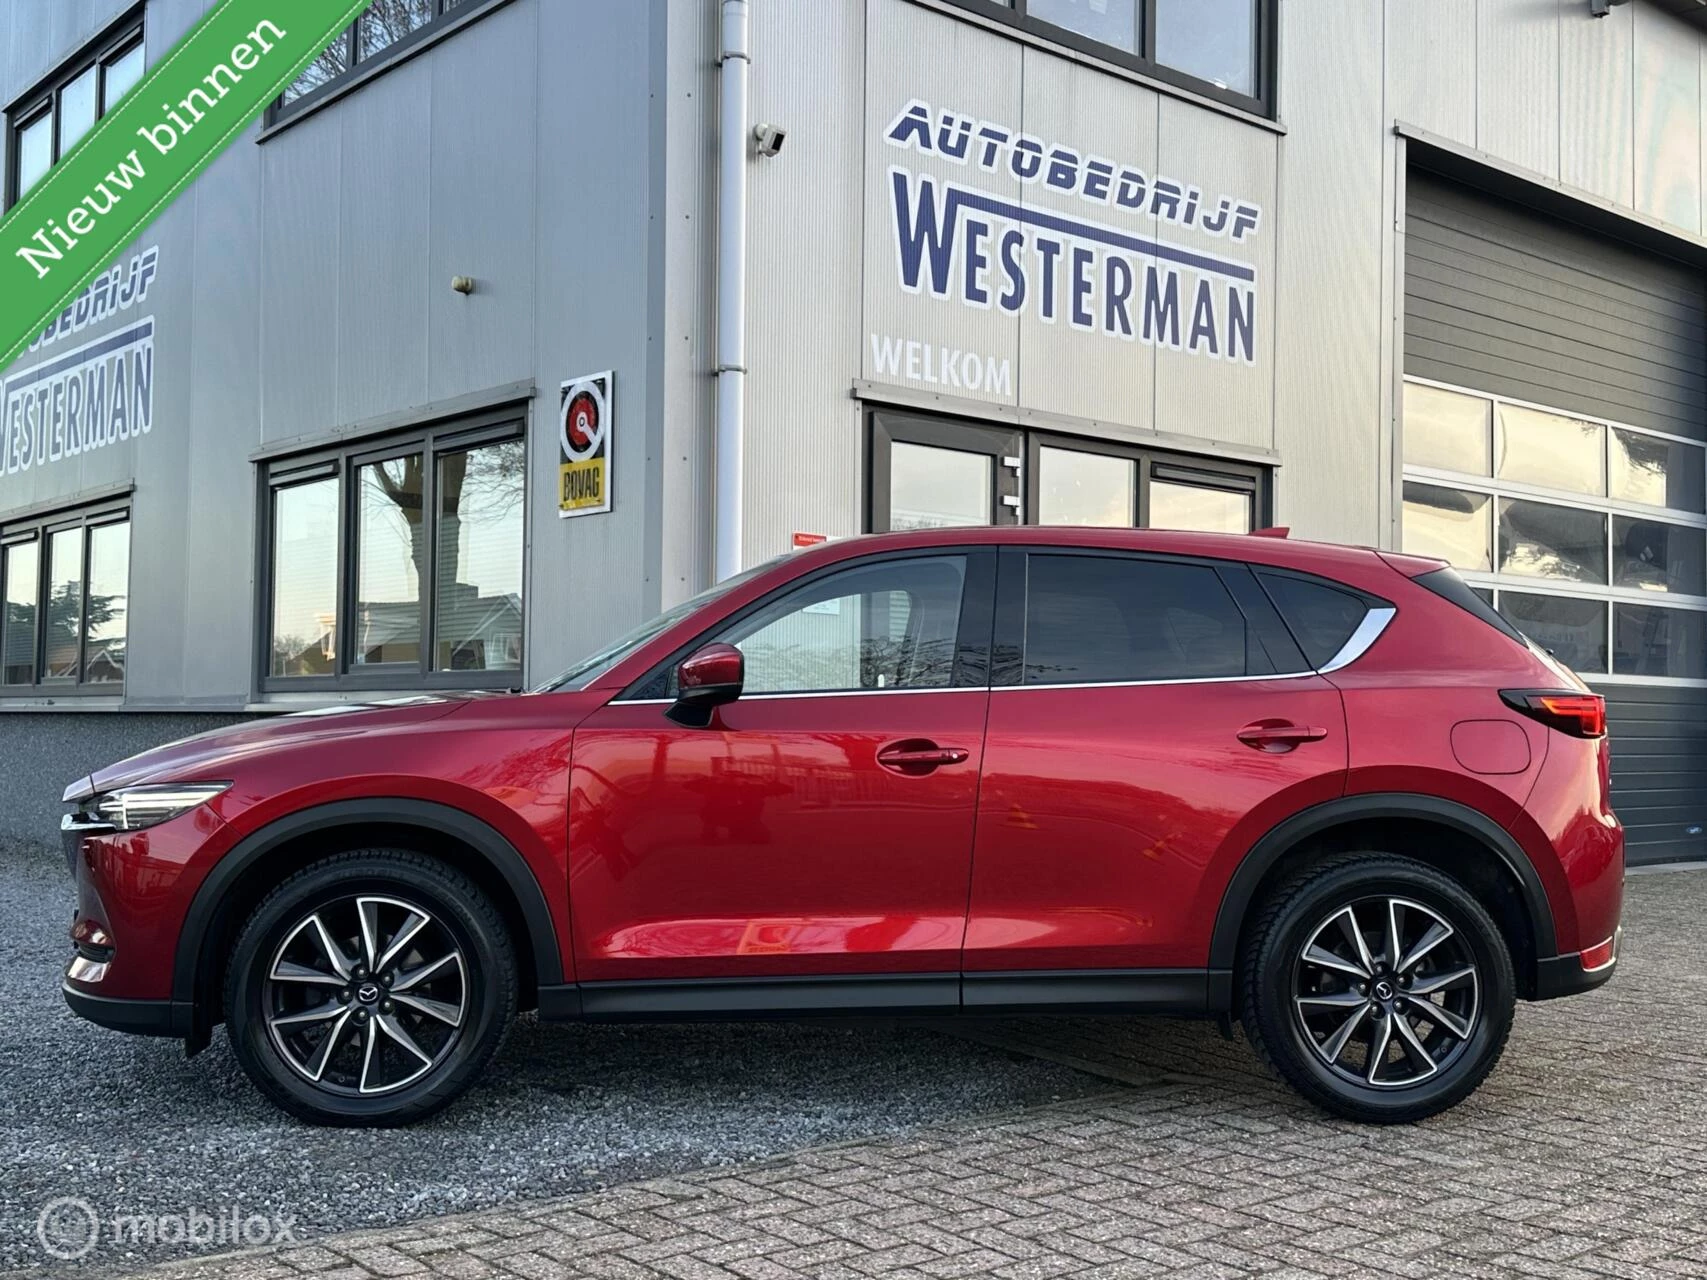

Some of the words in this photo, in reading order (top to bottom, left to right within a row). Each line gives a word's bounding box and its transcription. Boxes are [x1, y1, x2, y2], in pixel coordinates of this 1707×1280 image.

[887, 104, 1259, 239] AUTOBEDRIJF
[892, 171, 1255, 362] WESTERMAN
[871, 334, 1012, 396] WELKOM
[563, 467, 600, 502] BOVAG
